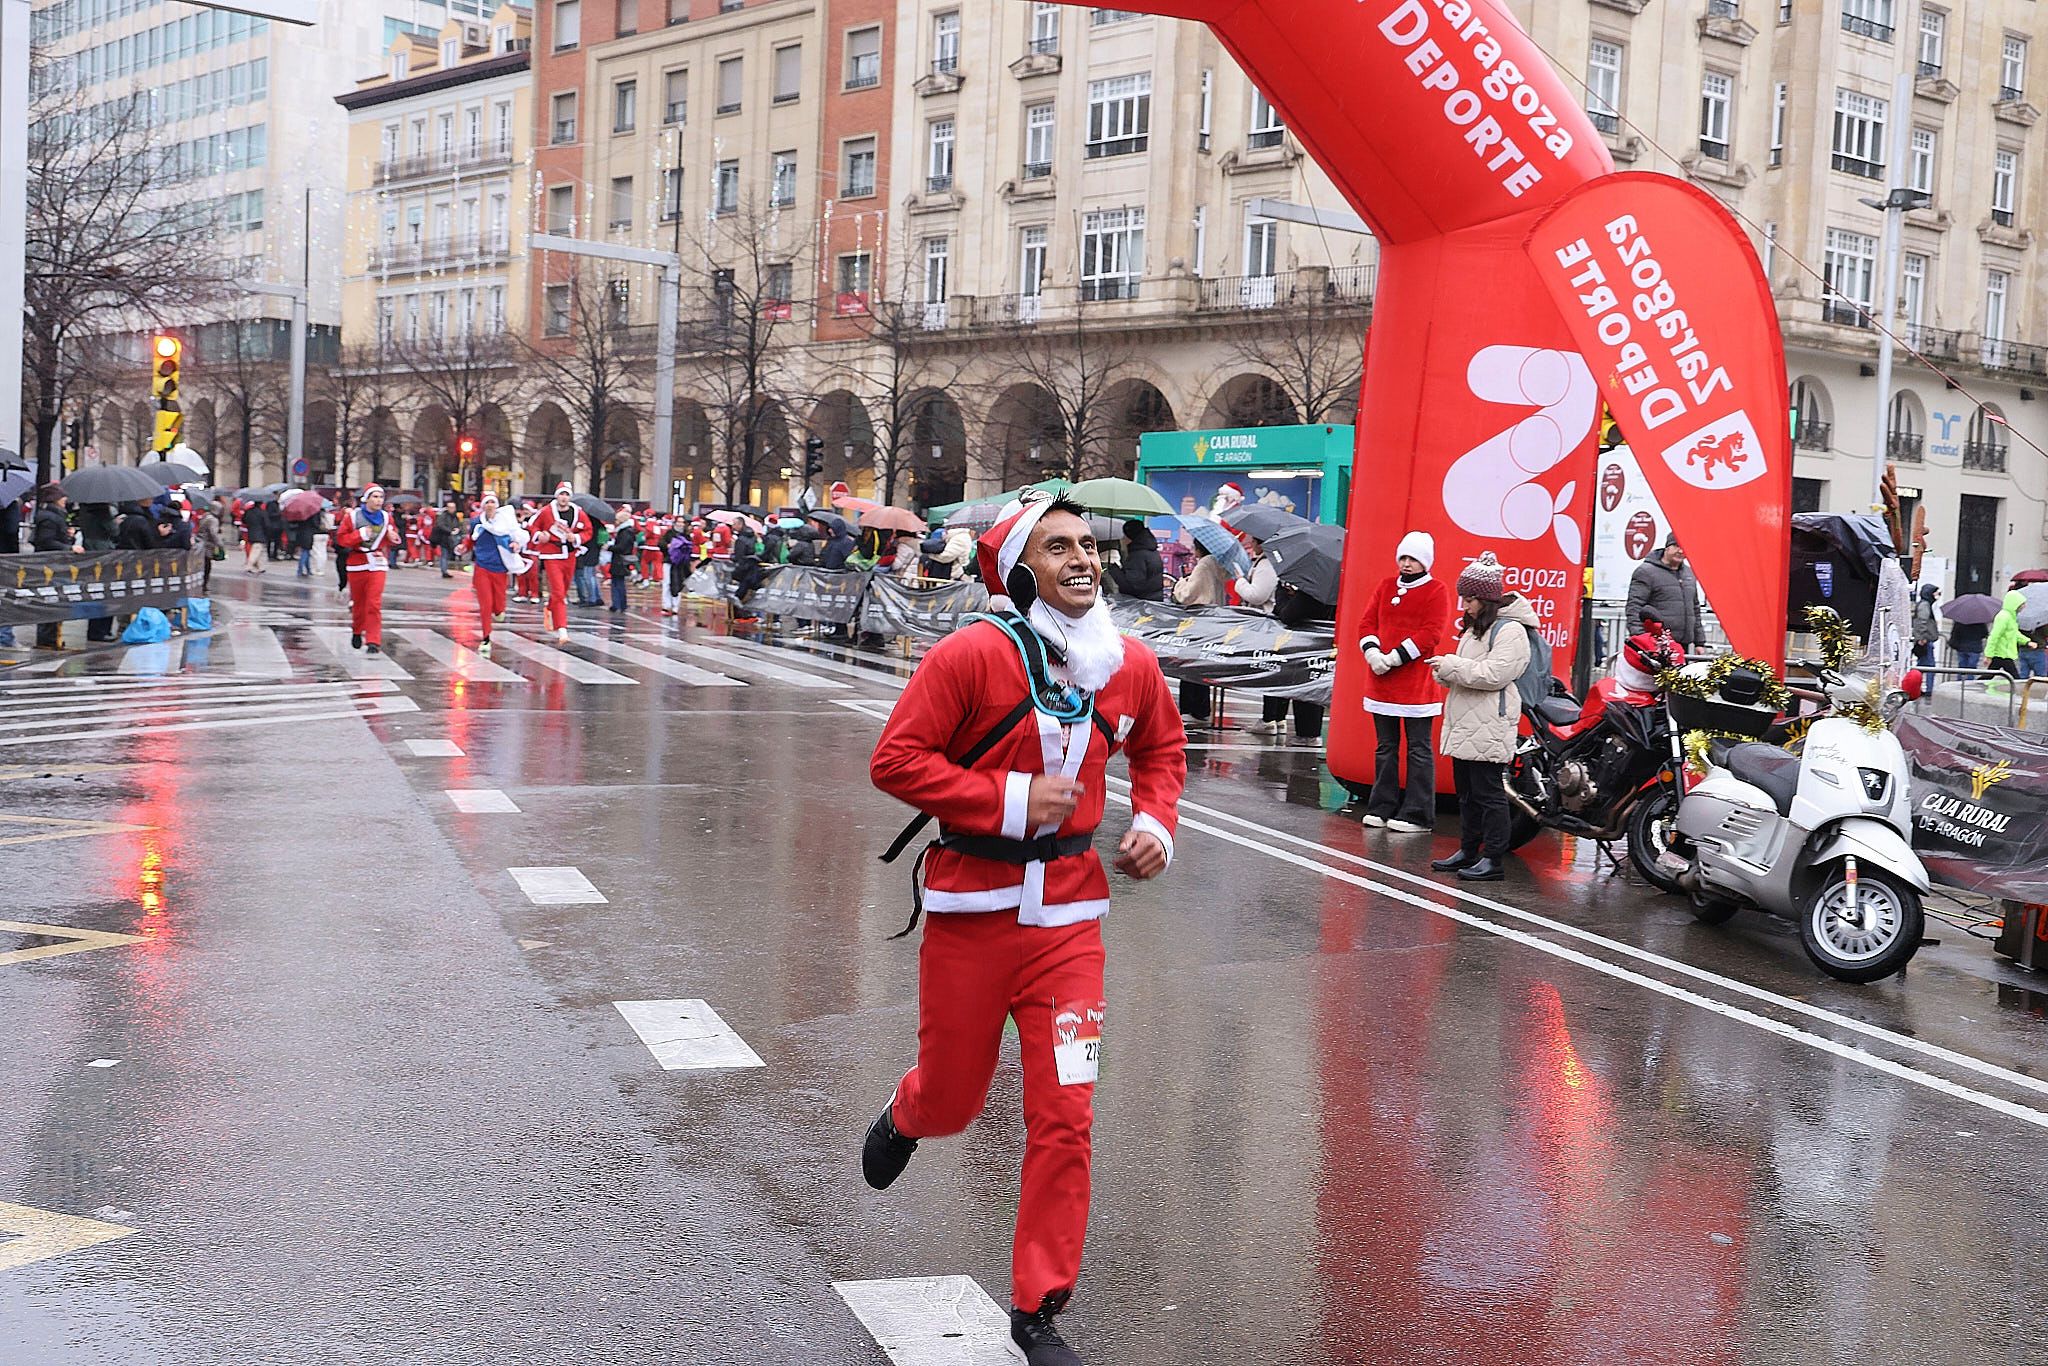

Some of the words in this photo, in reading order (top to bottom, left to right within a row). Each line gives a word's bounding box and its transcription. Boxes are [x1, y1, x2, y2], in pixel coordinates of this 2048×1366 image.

[1432, 0, 1573, 160] aragoza
[1377, 0, 1544, 198] DEPORTE
[1210, 435, 1230, 449] CAJA
[1231, 434, 1258, 449] RURAL
[1214, 452, 1224, 462] DE
[1921, 793, 1961, 819] CAJA
[1956, 803, 2011, 833] RURAL
[1919, 815, 1937, 832] DE
[1934, 820, 1987, 848] ARAGÓN
